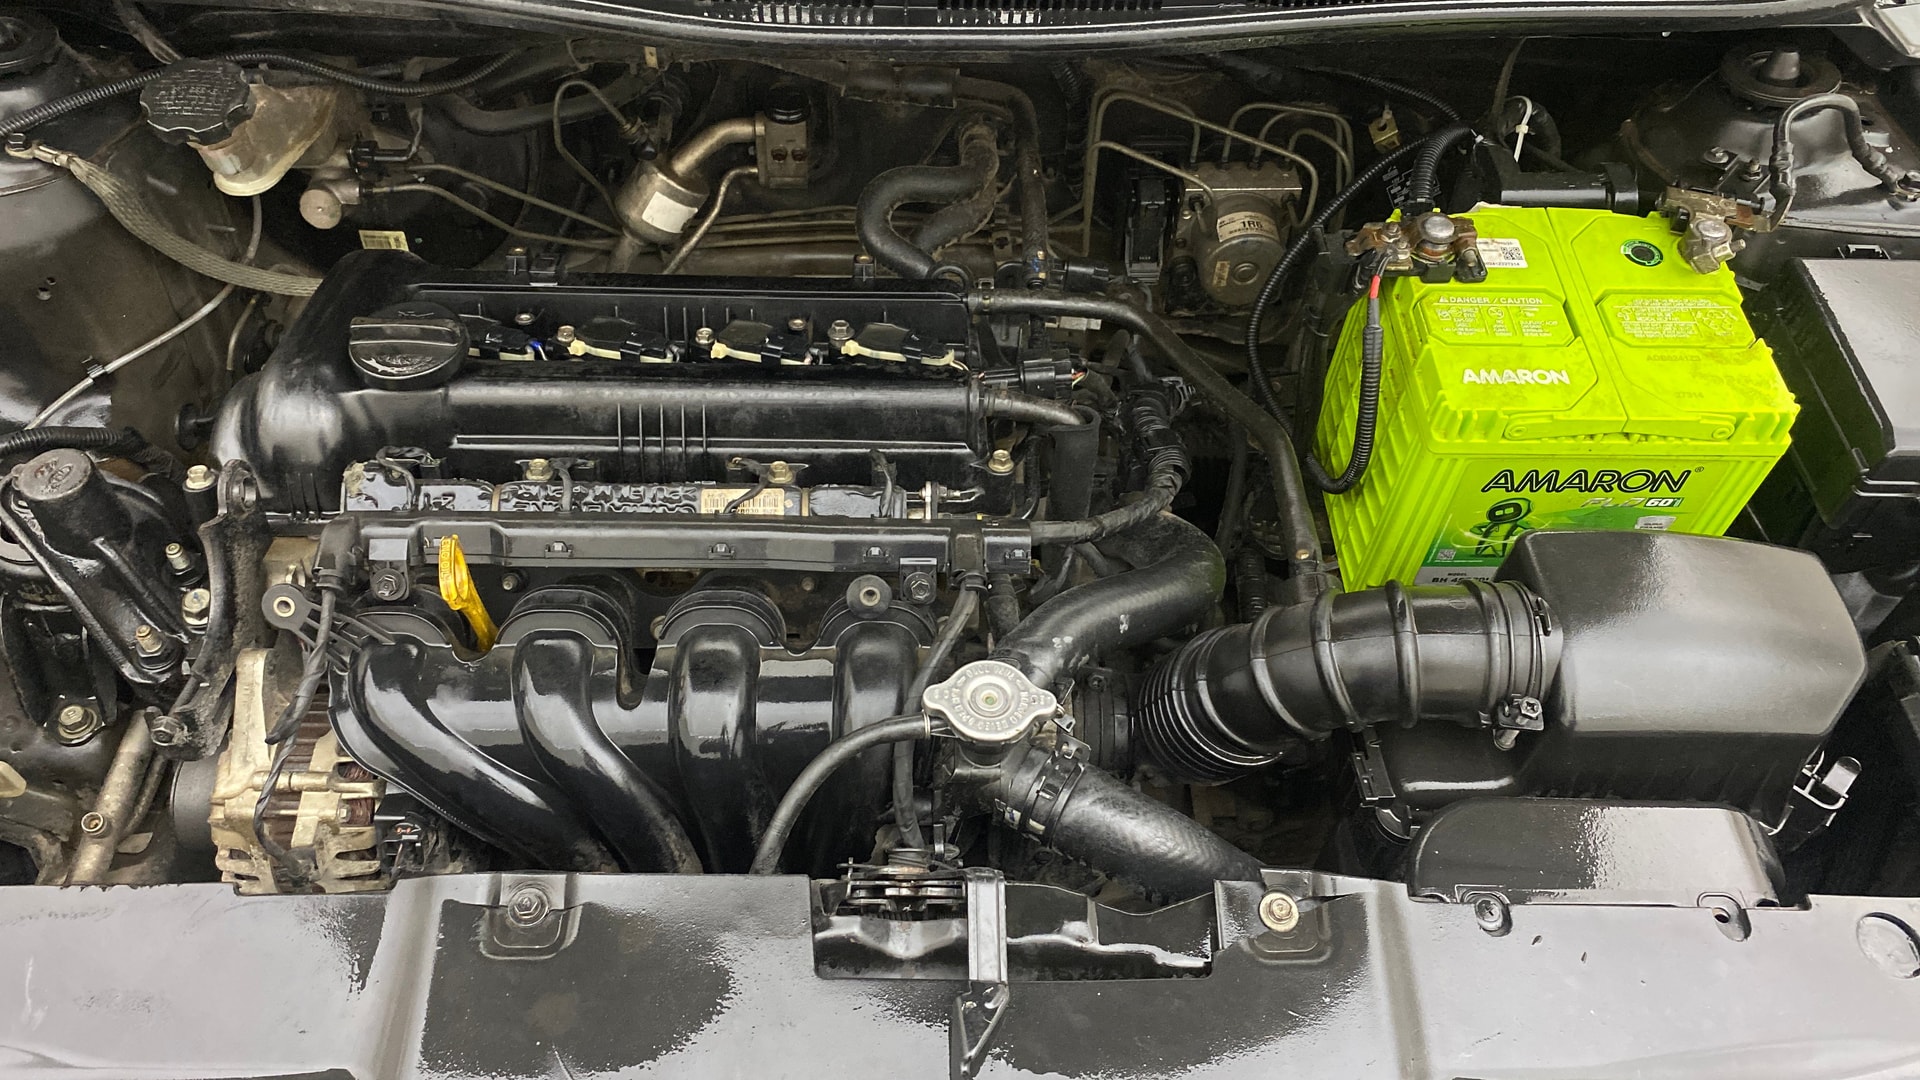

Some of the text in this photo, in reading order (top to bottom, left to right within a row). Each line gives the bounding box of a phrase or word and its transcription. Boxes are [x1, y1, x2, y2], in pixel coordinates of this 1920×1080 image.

[1500, 297, 1543, 305] CAUTION
[1462, 368, 1570, 385] AMARON
[1481, 469, 1692, 493] AMARON
